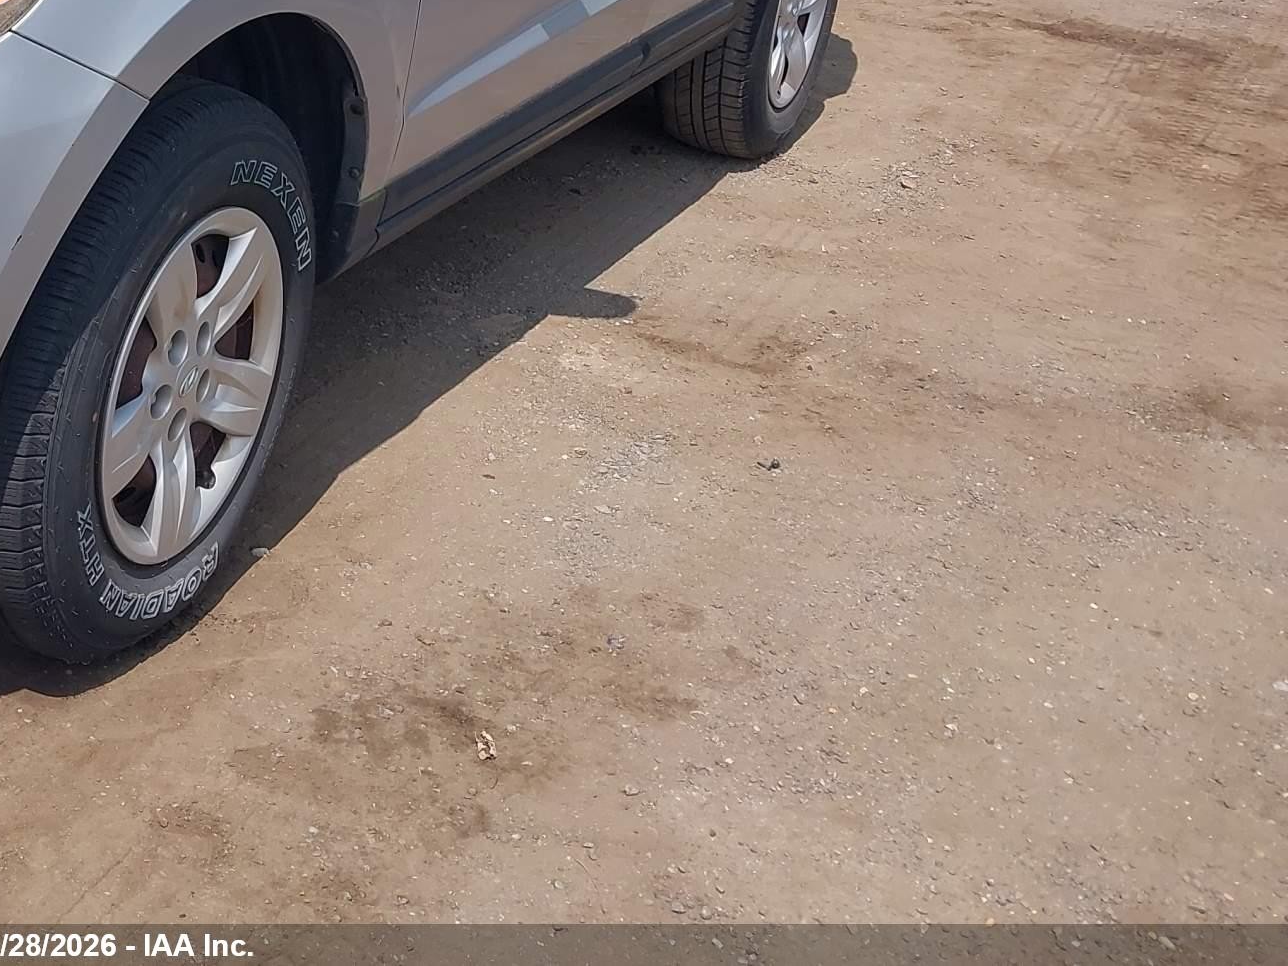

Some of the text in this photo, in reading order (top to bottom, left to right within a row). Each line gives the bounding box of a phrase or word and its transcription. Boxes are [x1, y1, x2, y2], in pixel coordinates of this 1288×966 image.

[230, 159, 312, 272] NEXEN
[77, 499, 219, 621] ROADIAN HTX
